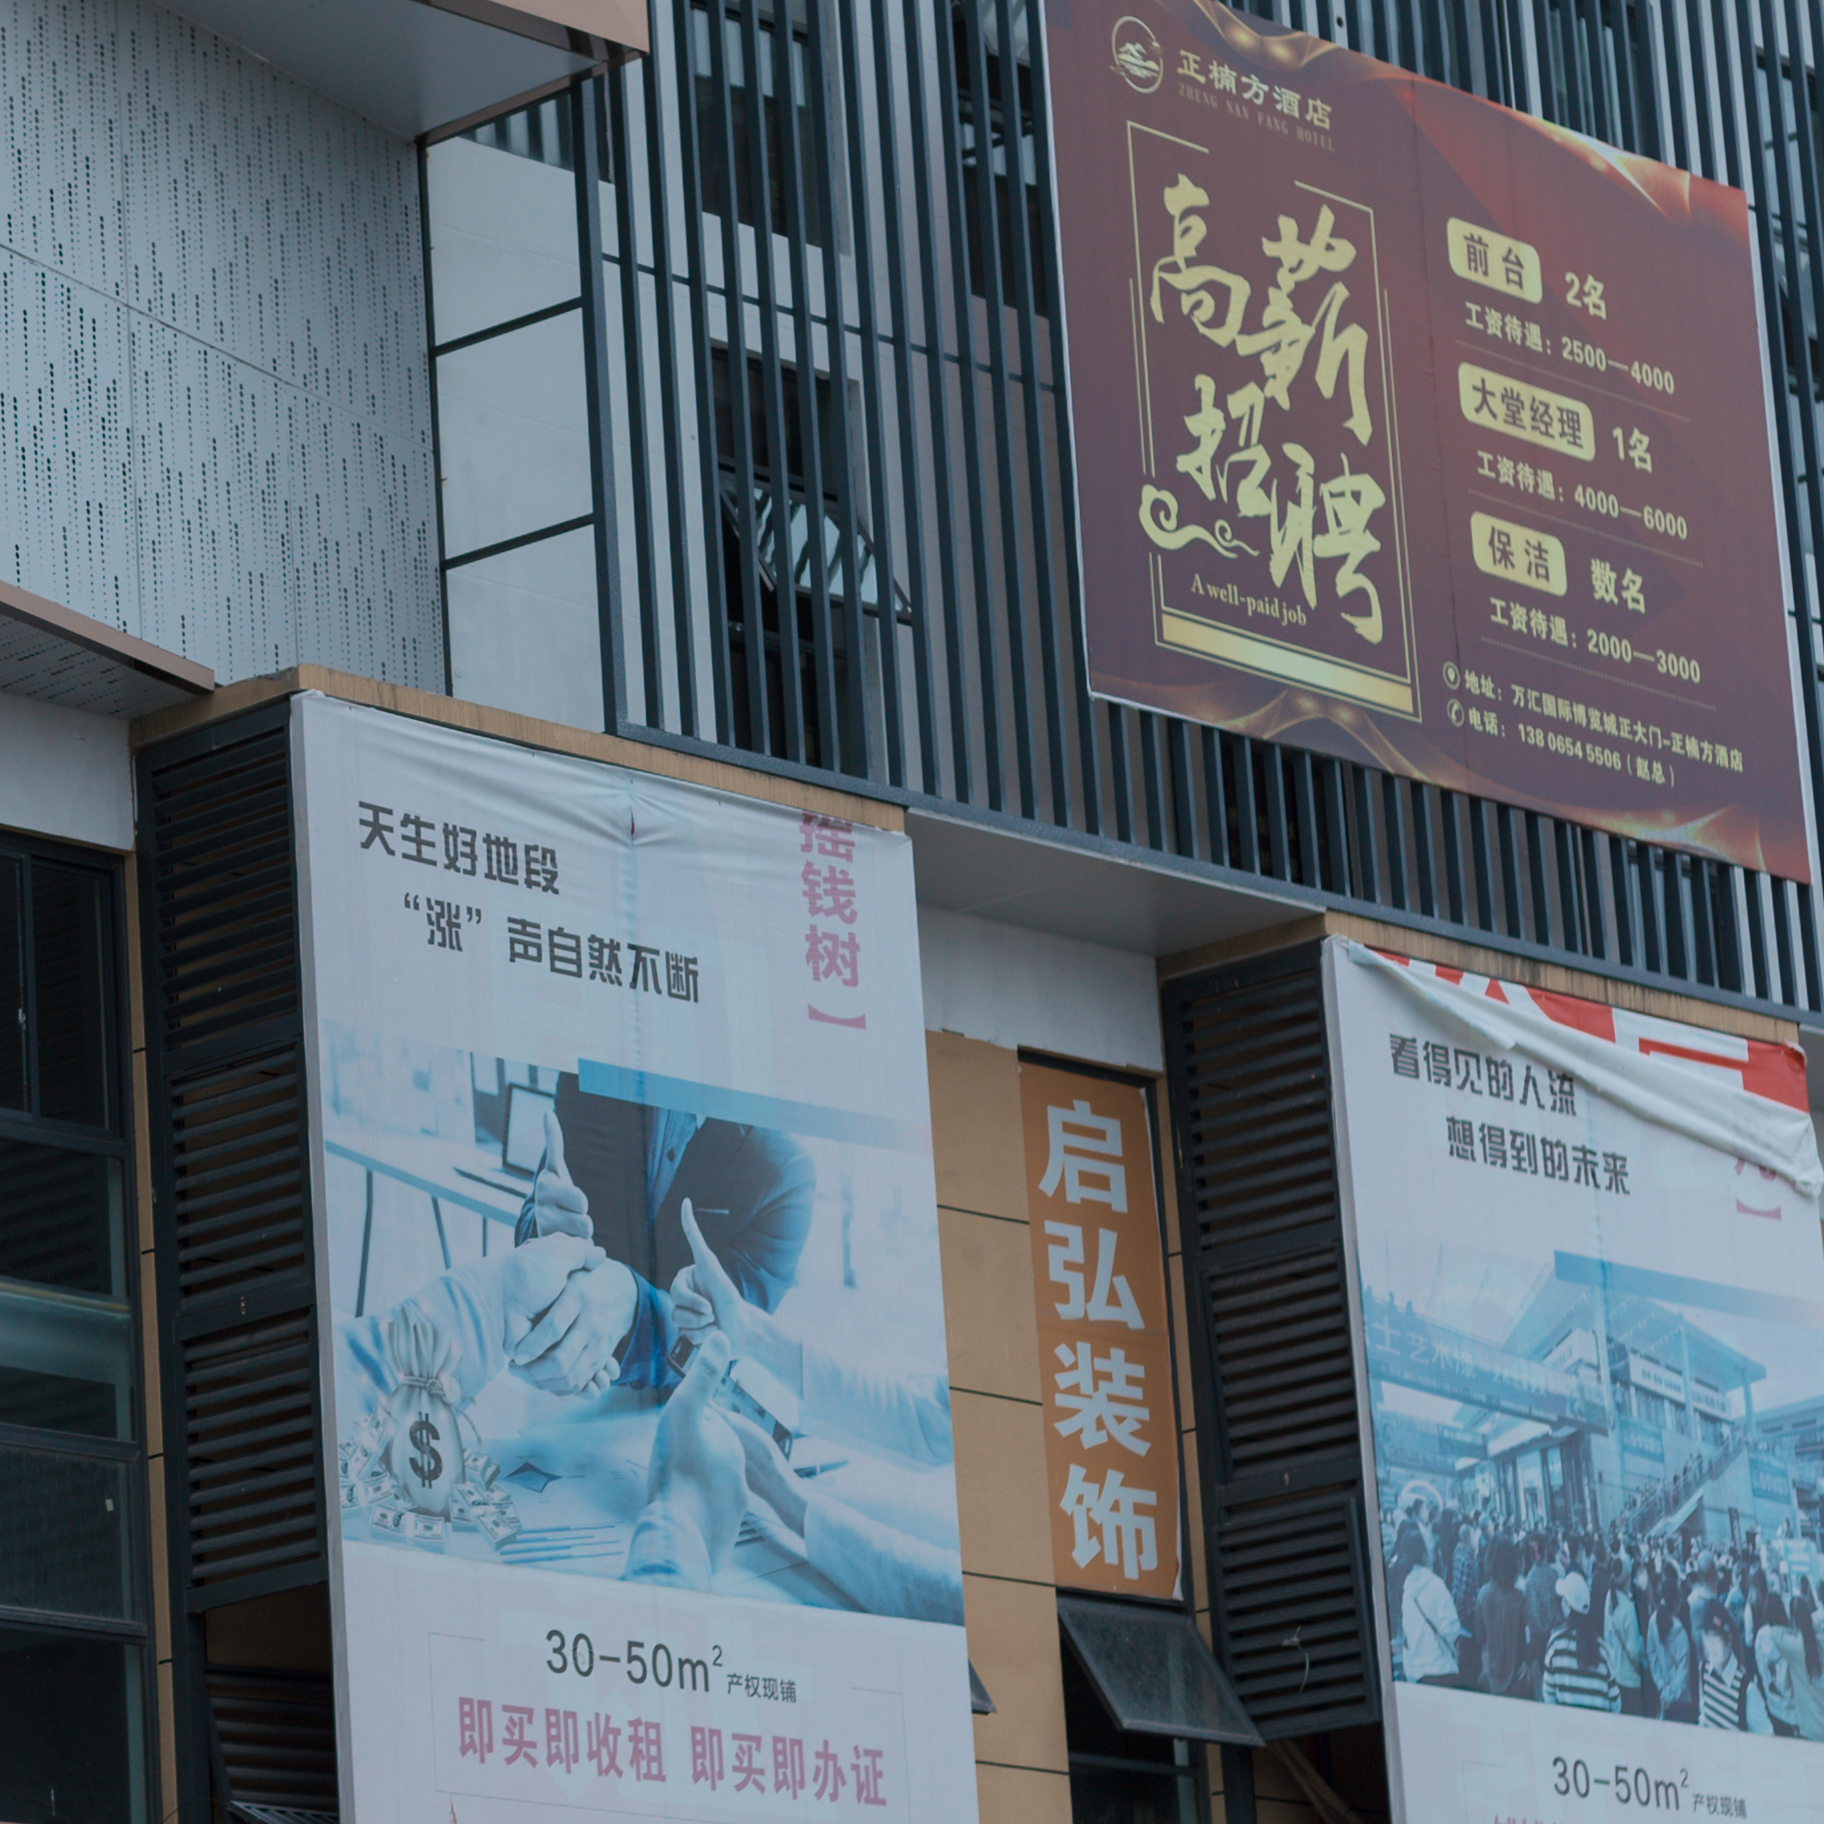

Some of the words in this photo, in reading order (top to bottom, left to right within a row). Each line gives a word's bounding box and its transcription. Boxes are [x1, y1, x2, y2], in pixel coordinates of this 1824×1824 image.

[1177, 49, 1332, 131] 正楠方酒店
[1178, 82, 1218, 109] ZHENG
[1226, 99, 1250, 121] NAN
[1257, 110, 1289, 136] FANG
[1296, 126, 1335, 153] HOTEL
[1463, 232, 1525, 291] 前台
[1565, 271, 1607, 321] 2名
[1472, 376, 1584, 450] 大堂经理
[1612, 426, 1653, 474] 1名
[1176, 374, 1386, 644] 招聘
[1191, 572, 1206, 596] A
[1206, 582, 1281, 619] well-paid
[1281, 601, 1308, 627] job
[1488, 526, 1551, 583] 保洁
[1590, 557, 1646, 614] 数名
[1547, 733, 1584, 760] 0654
[358, 800, 560, 896] 天生好地段
[1389, 1033, 1577, 1116] 看得见的人流
[1445, 1115, 1631, 1195] 想得到的未来
[1038, 1099, 1159, 1580] 启弘装饰
[726, 1672, 798, 1705] 产权现铺
[458, 1696, 667, 1783] 即买即收租
[690, 1725, 888, 1807] 即买即办证
